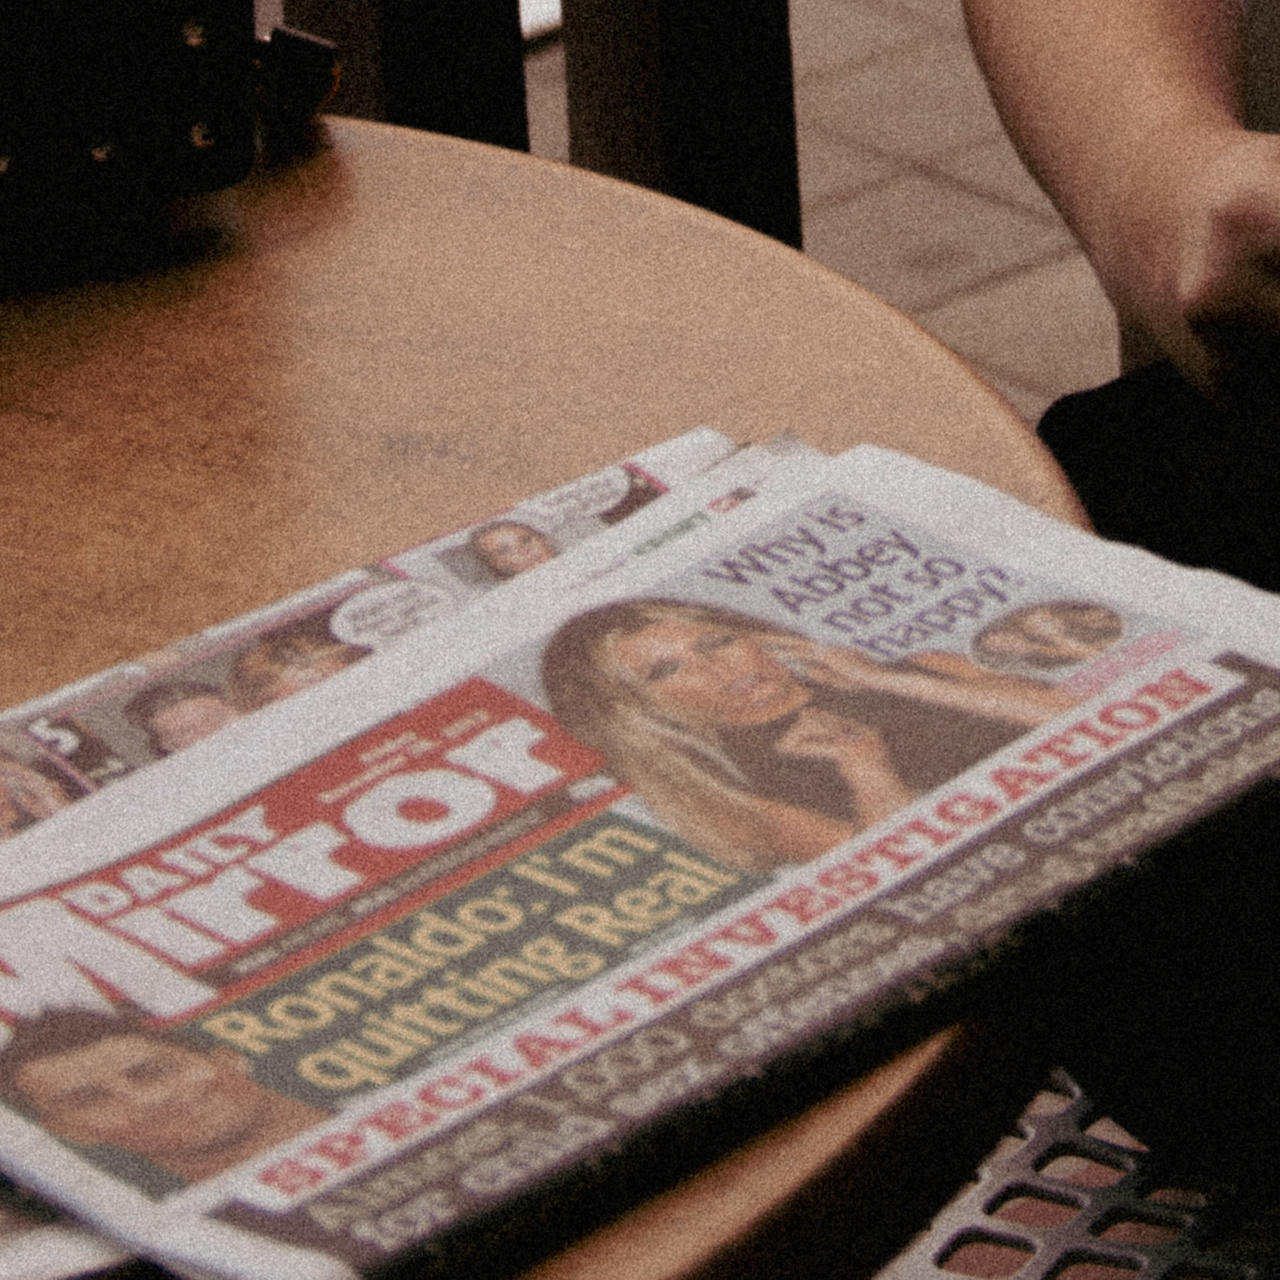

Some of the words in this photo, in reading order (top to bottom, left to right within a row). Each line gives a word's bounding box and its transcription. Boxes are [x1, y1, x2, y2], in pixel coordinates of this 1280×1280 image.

[701, 525, 827, 586] Why
[770, 529, 921, 613] Abbey
[822, 582, 915, 634] not
[904, 555, 967, 590] so
[0, 716, 567, 1035] Mirror
[61, 804, 278, 919] DAILY
[871, 838, 1028, 923] have
[202, 884, 549, 1054] Ronaldo:
[512, 824, 660, 896] I'm
[257, 1007, 636, 1197] SPECIAL
[612, 668, 1213, 1005] INVESTIGATION
[300, 935, 603, 1090] quitting
[555, 851, 743, 947] Real
